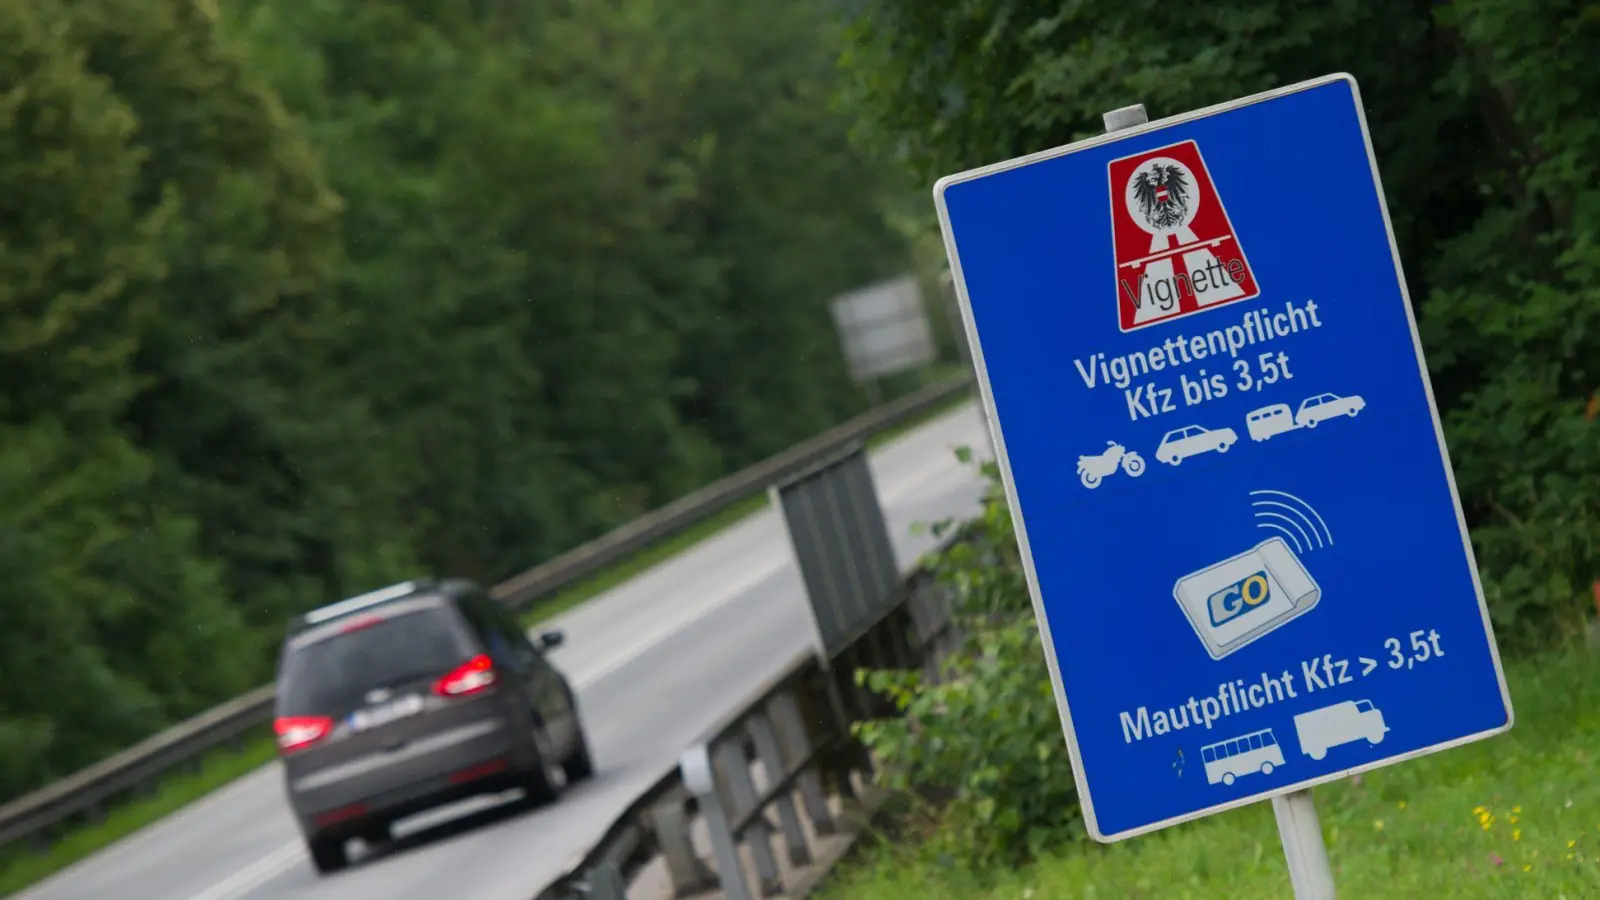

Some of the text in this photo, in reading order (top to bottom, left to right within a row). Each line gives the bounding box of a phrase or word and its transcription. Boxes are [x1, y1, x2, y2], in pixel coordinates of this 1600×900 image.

[1121, 256, 1246, 311] Vignette
[1073, 299, 1322, 389] Vignettenpflicht
[1125, 350, 1293, 421] Kfz bis 3,5t
[1222, 574, 1269, 613] GO
[1119, 628, 1445, 744] Mautpflicht Kfz > 3,5t
